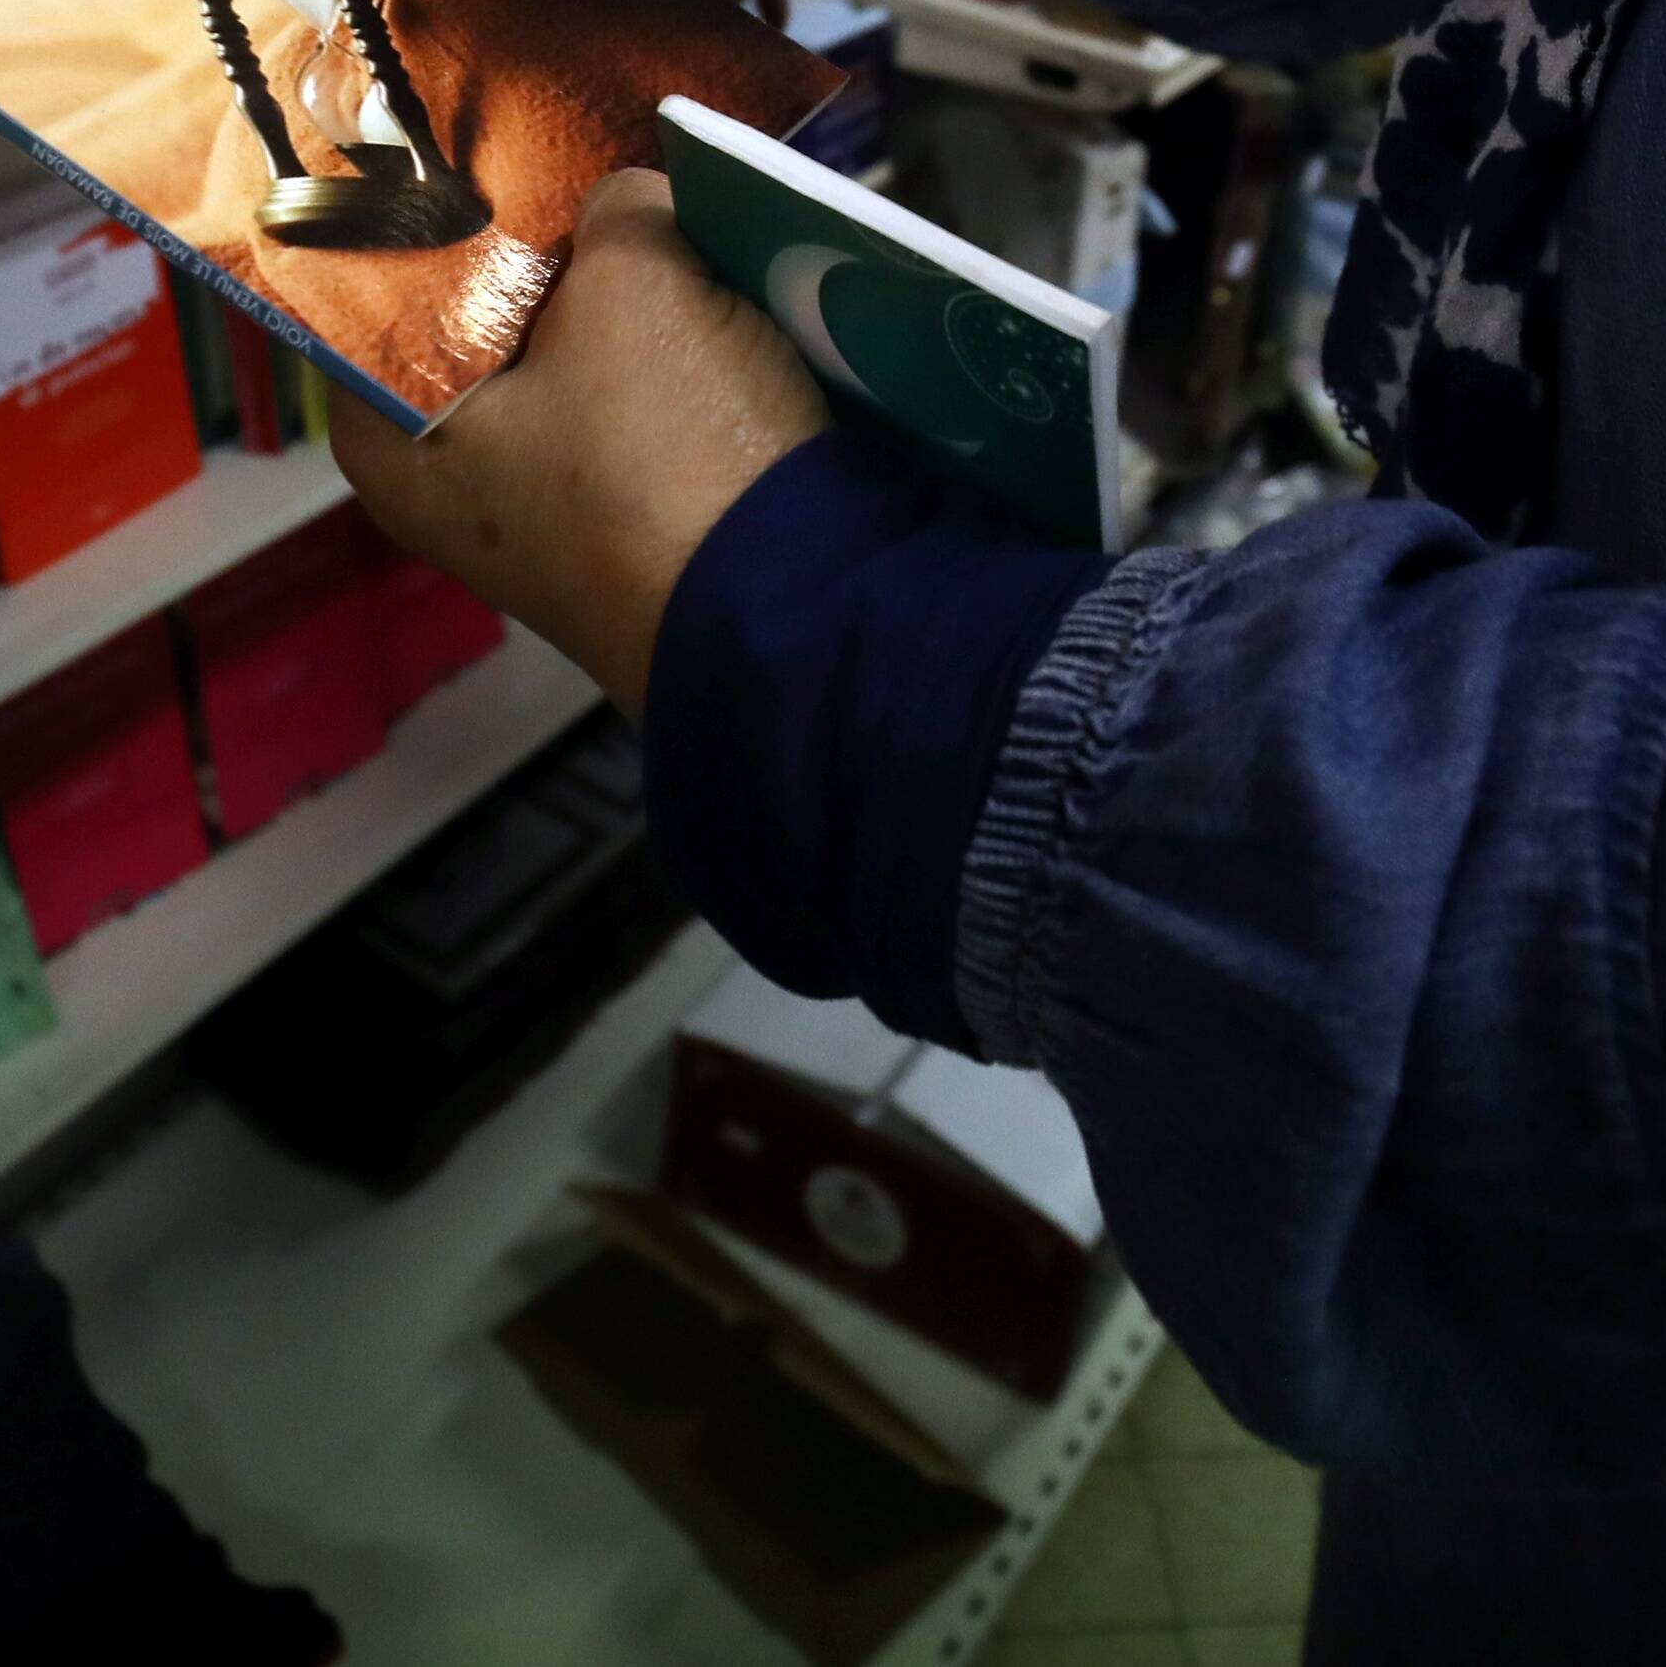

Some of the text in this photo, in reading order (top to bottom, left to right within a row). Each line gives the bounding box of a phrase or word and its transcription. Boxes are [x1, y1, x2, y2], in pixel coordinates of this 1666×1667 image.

[31, 141, 311, 356] VOICI VENU LE MOIS DE RAMADAN
